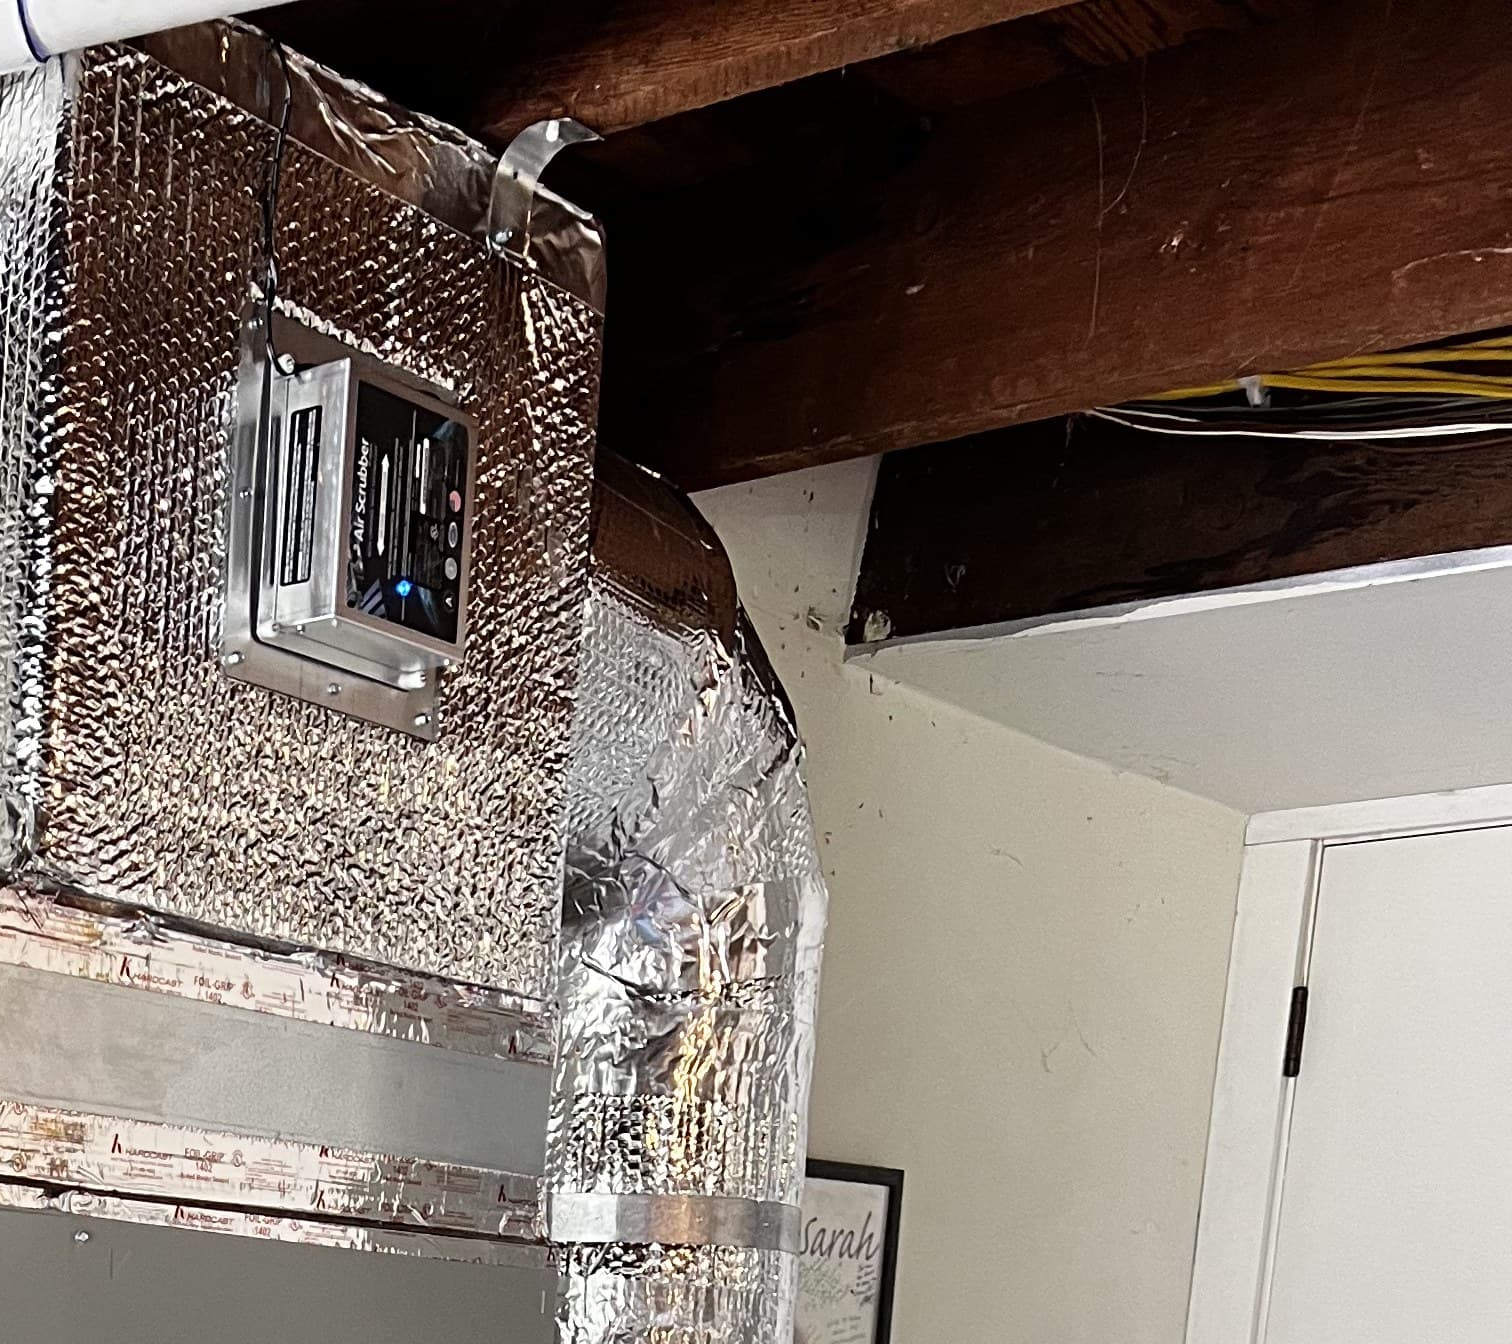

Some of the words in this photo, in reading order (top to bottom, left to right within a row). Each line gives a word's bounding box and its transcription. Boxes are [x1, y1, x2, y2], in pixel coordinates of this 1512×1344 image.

[355, 437, 370, 514] Scrubber
[353, 516, 365, 542] Air
[193, 975, 236, 992] FOIL-GRIP
[205, 991, 223, 1002] 1402
[184, 1148, 226, 1162] FOIL-GRIP
[195, 1161, 213, 1173] 1402
[800, 1210, 880, 1261] Sarah
